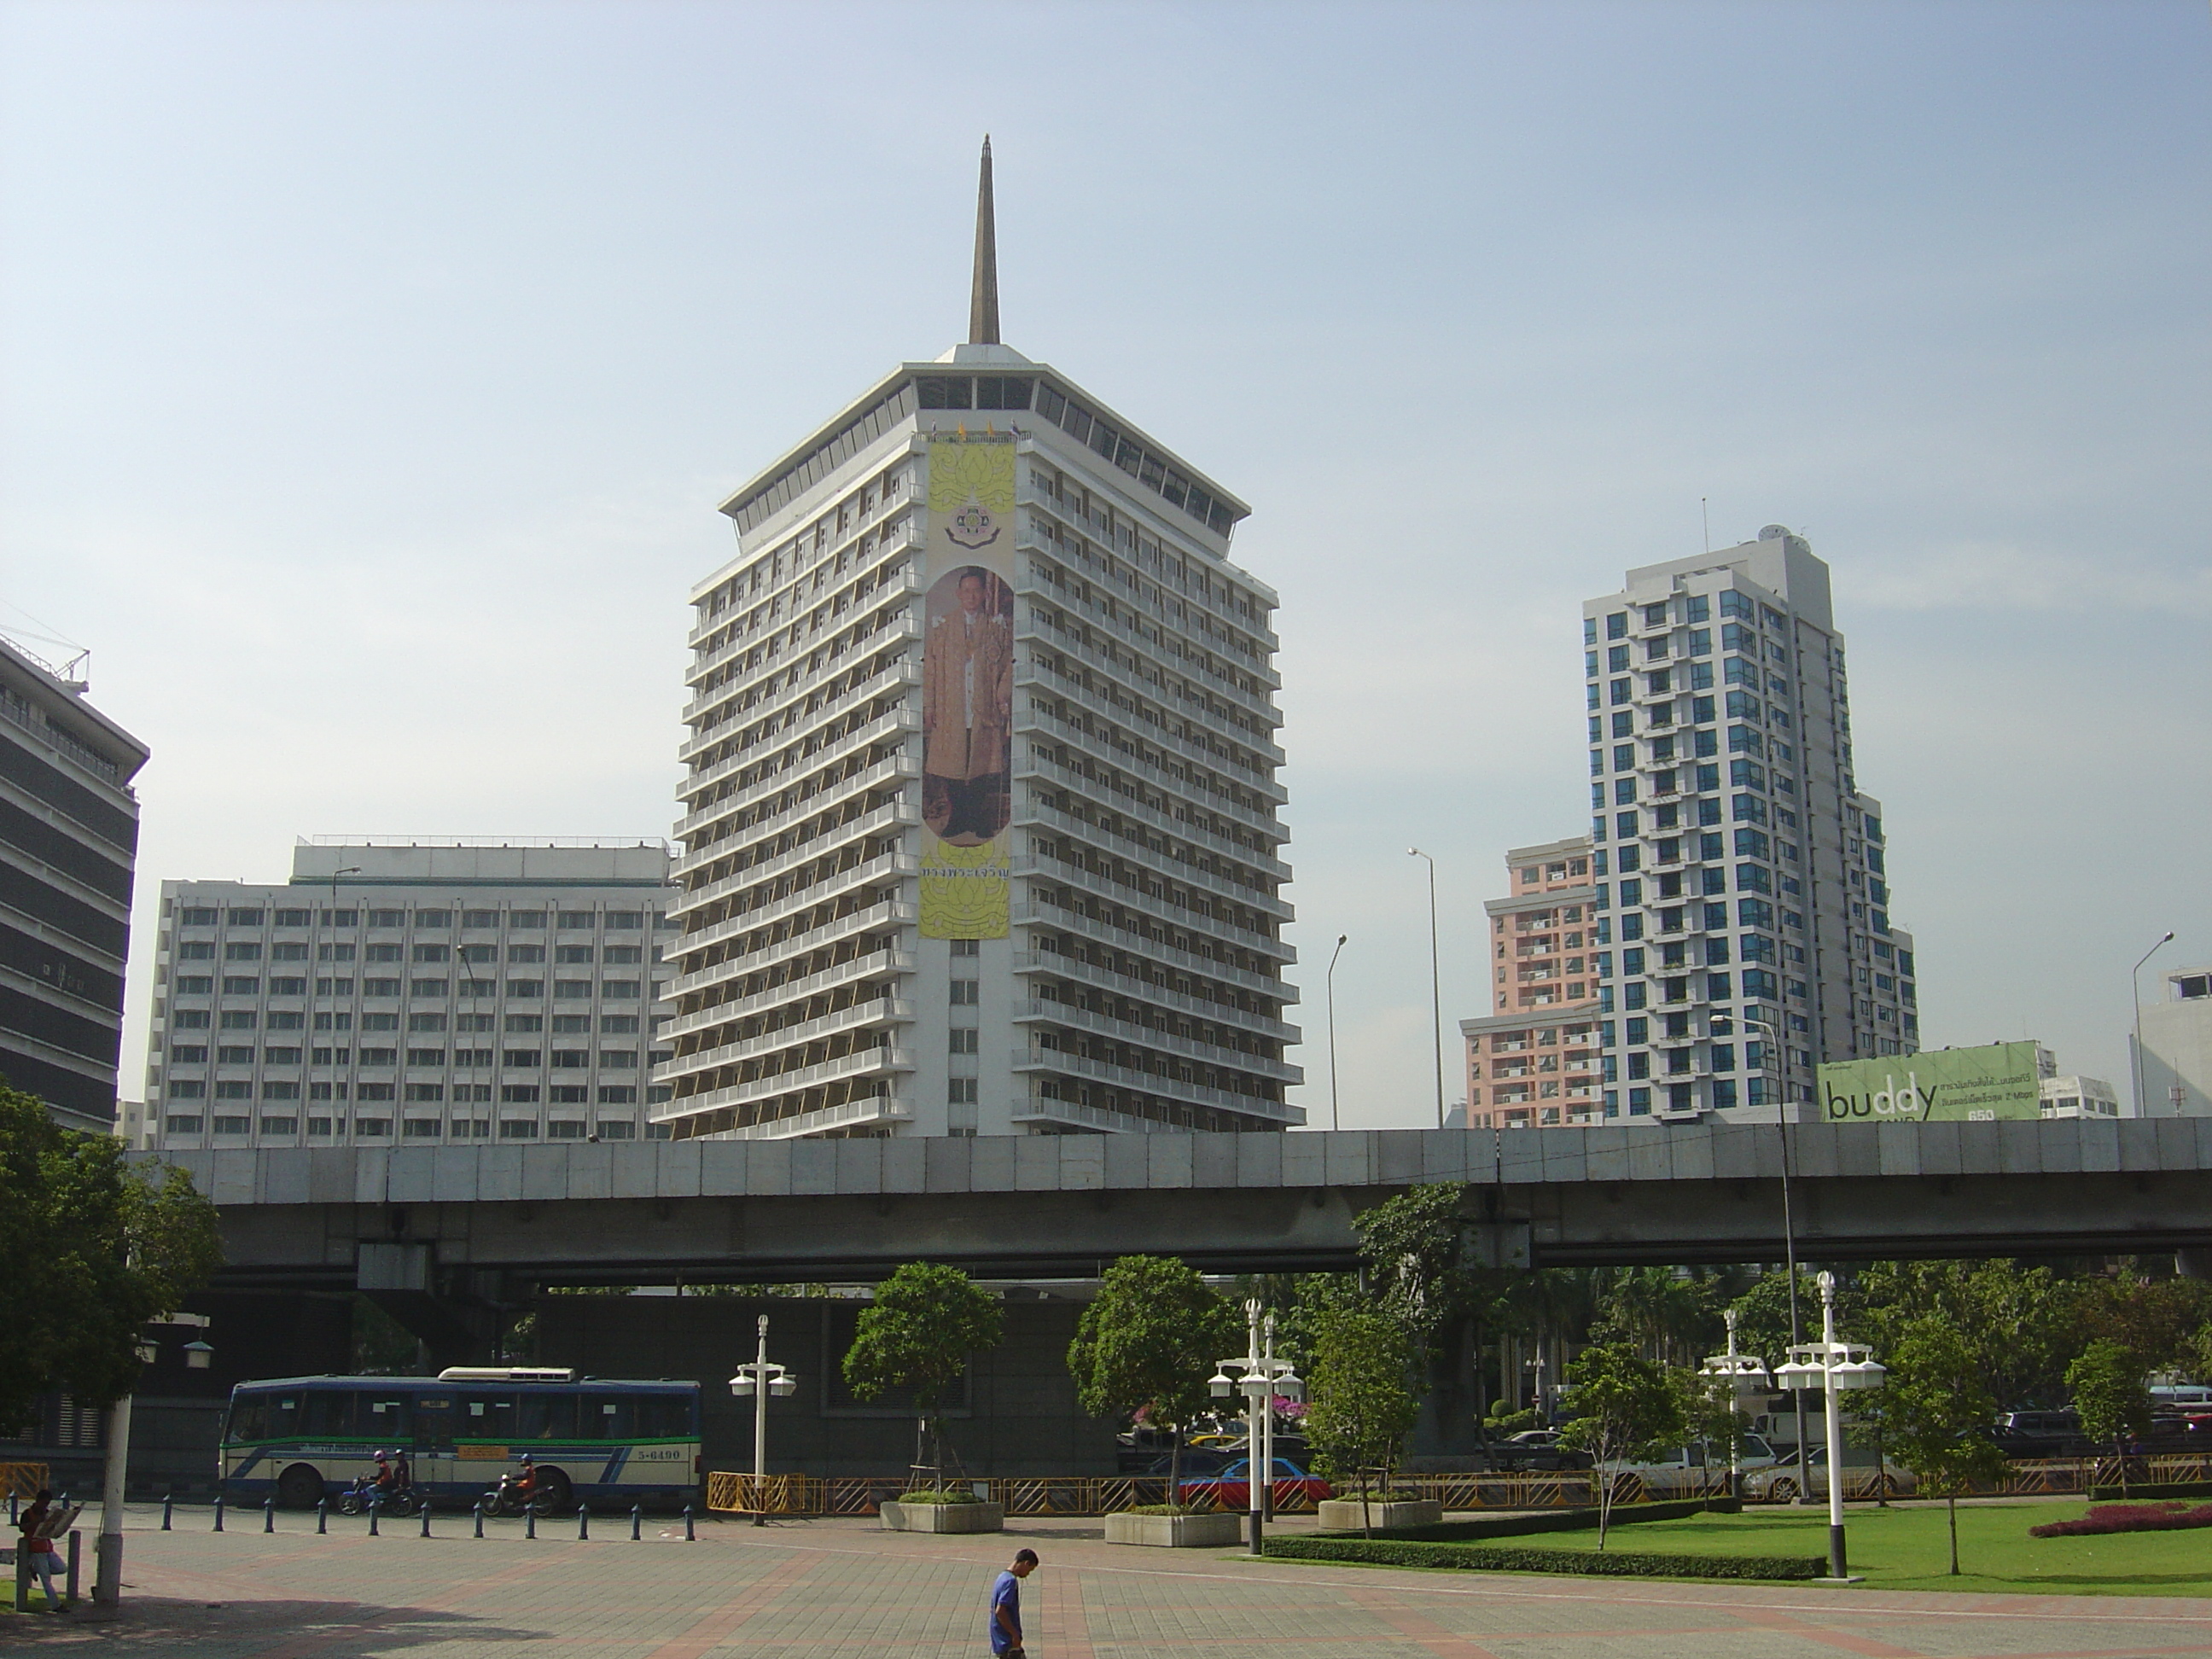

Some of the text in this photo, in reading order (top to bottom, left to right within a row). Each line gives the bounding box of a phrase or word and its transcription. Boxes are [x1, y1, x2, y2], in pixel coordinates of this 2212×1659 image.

[921, 864, 1010, 880] ทรงพระเจริญ
[1825, 1071, 1937, 1121] buddy
[1968, 1109, 1994, 1121] 650
